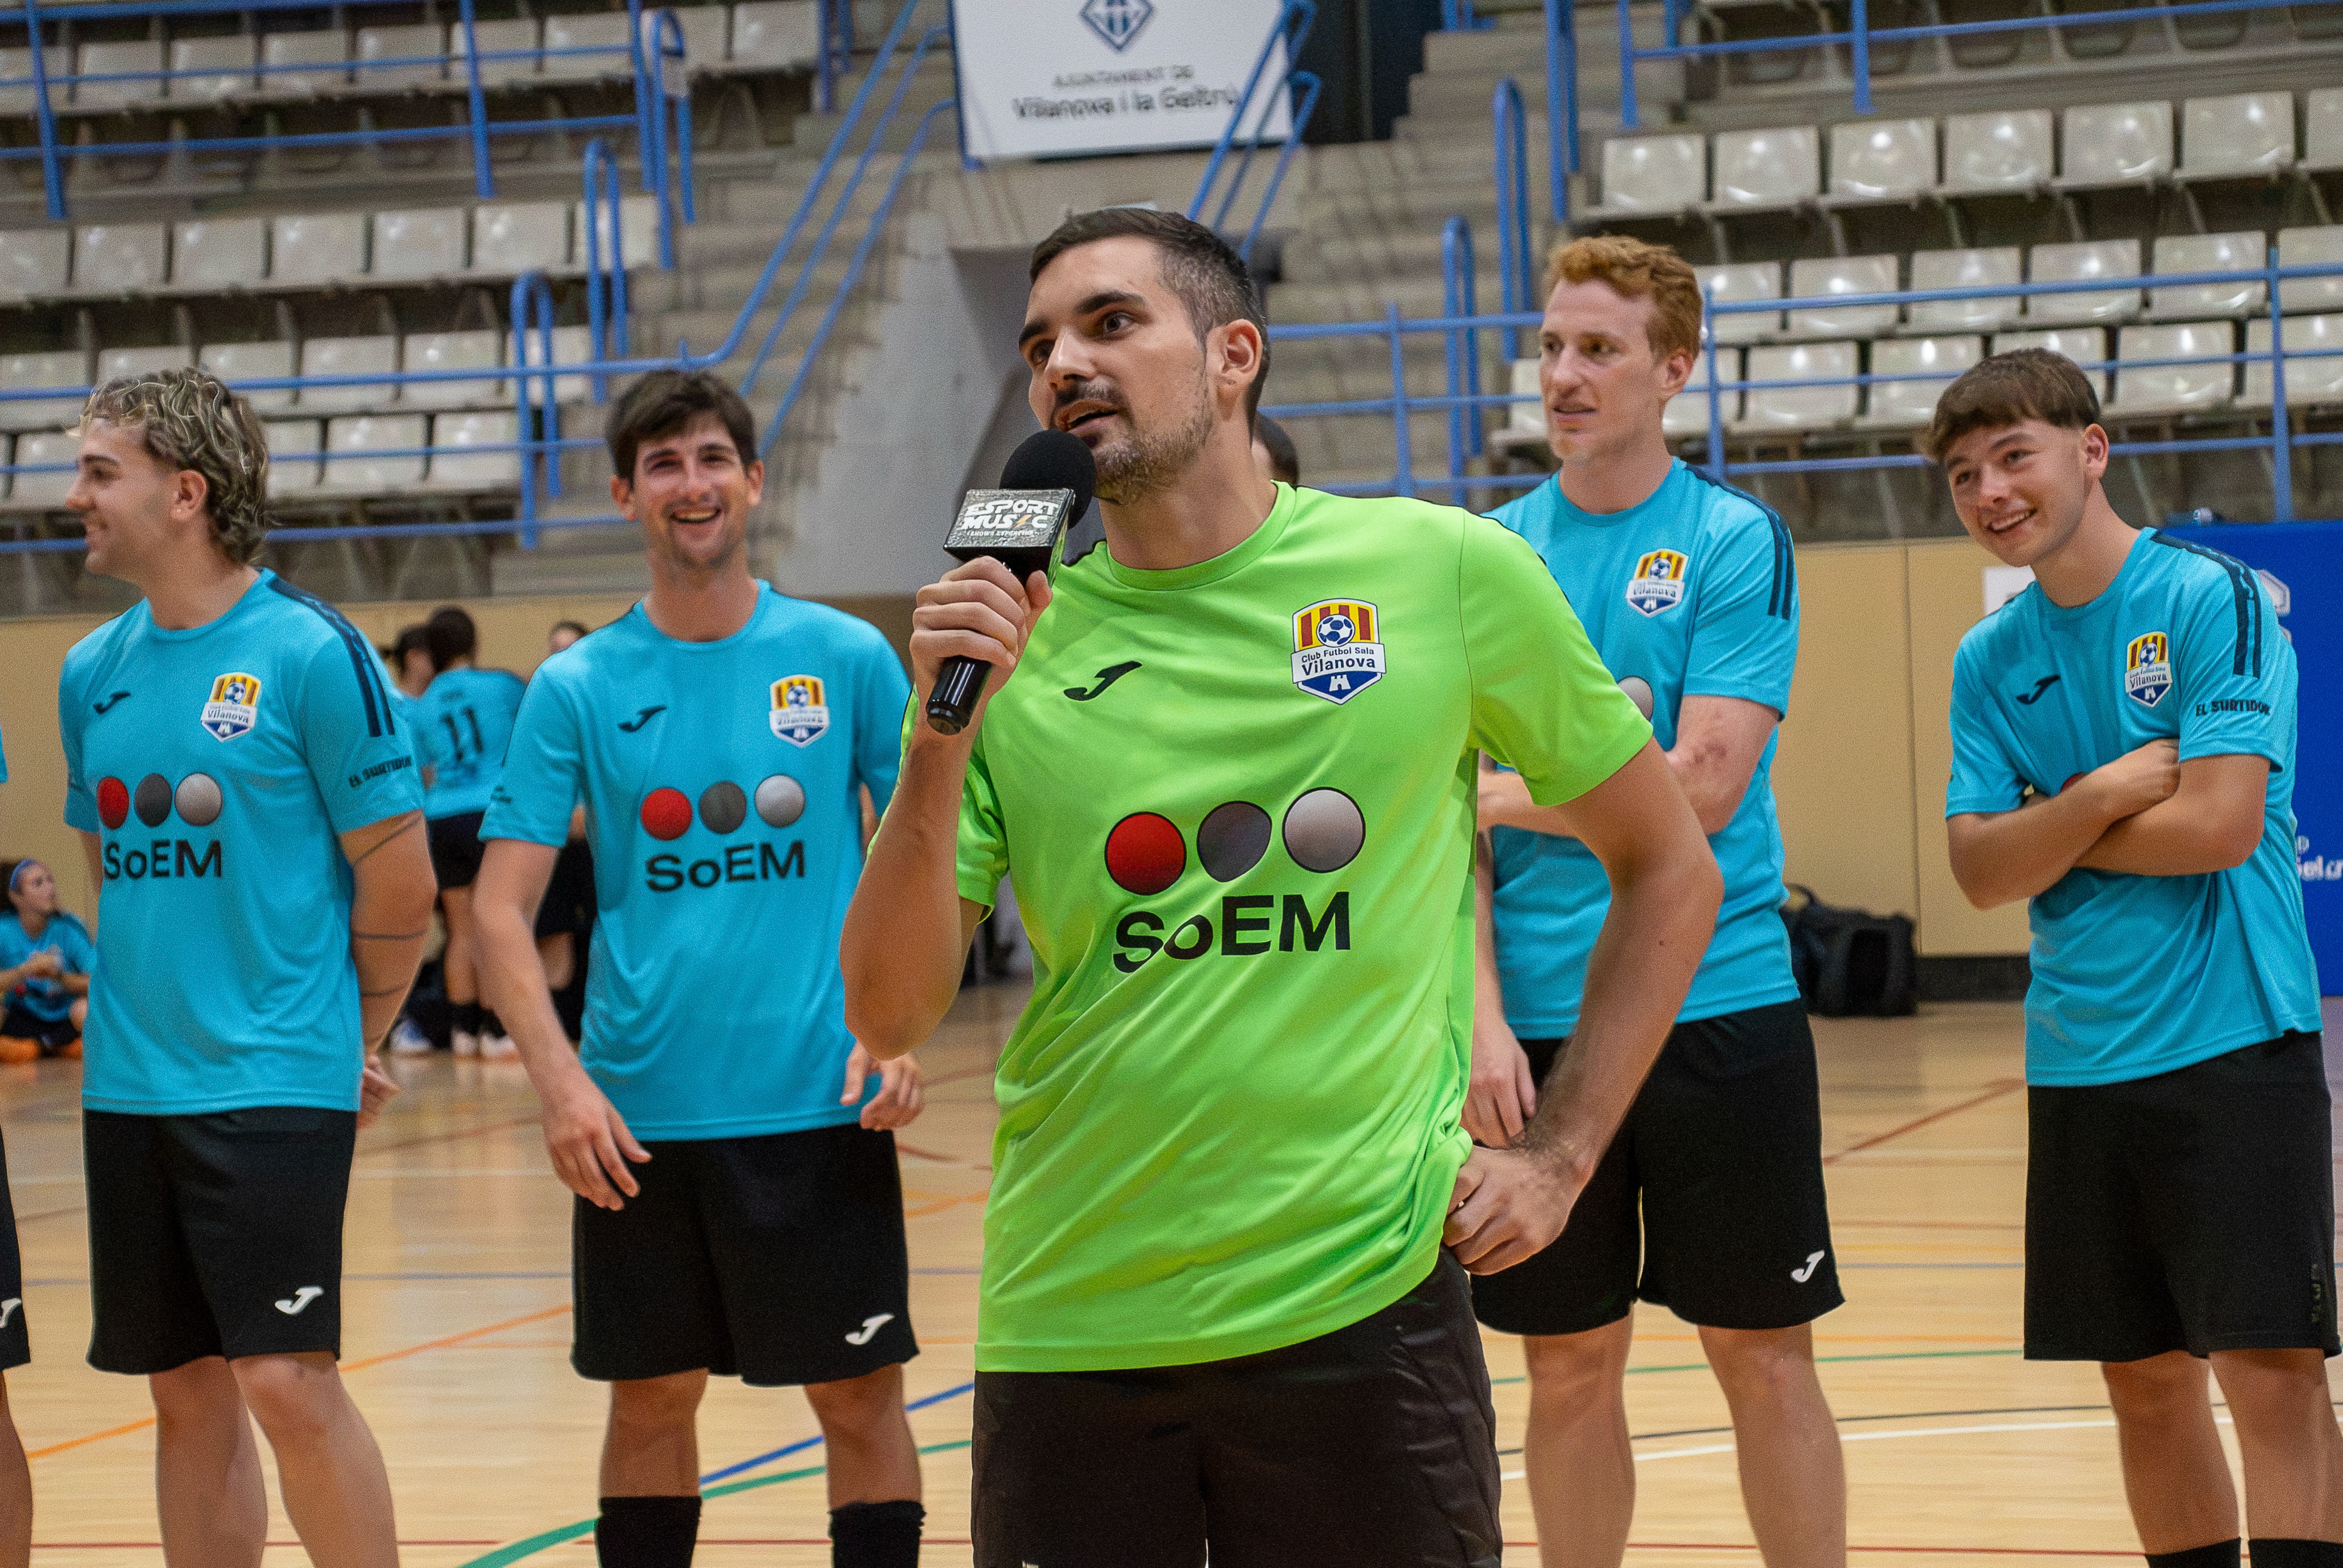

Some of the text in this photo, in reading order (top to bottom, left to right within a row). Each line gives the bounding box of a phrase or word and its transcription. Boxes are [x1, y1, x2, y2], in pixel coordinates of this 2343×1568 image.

[966, 499, 1059, 515] ESPORT
[1301, 652, 1321, 663] Club
[1324, 647, 1352, 657] Futbol
[1301, 658, 1376, 676] Vilanova
[439, 706, 483, 761] 11
[104, 839, 222, 880] SoEM
[645, 839, 805, 892] SoEM
[1113, 891, 1351, 974] SoEM
